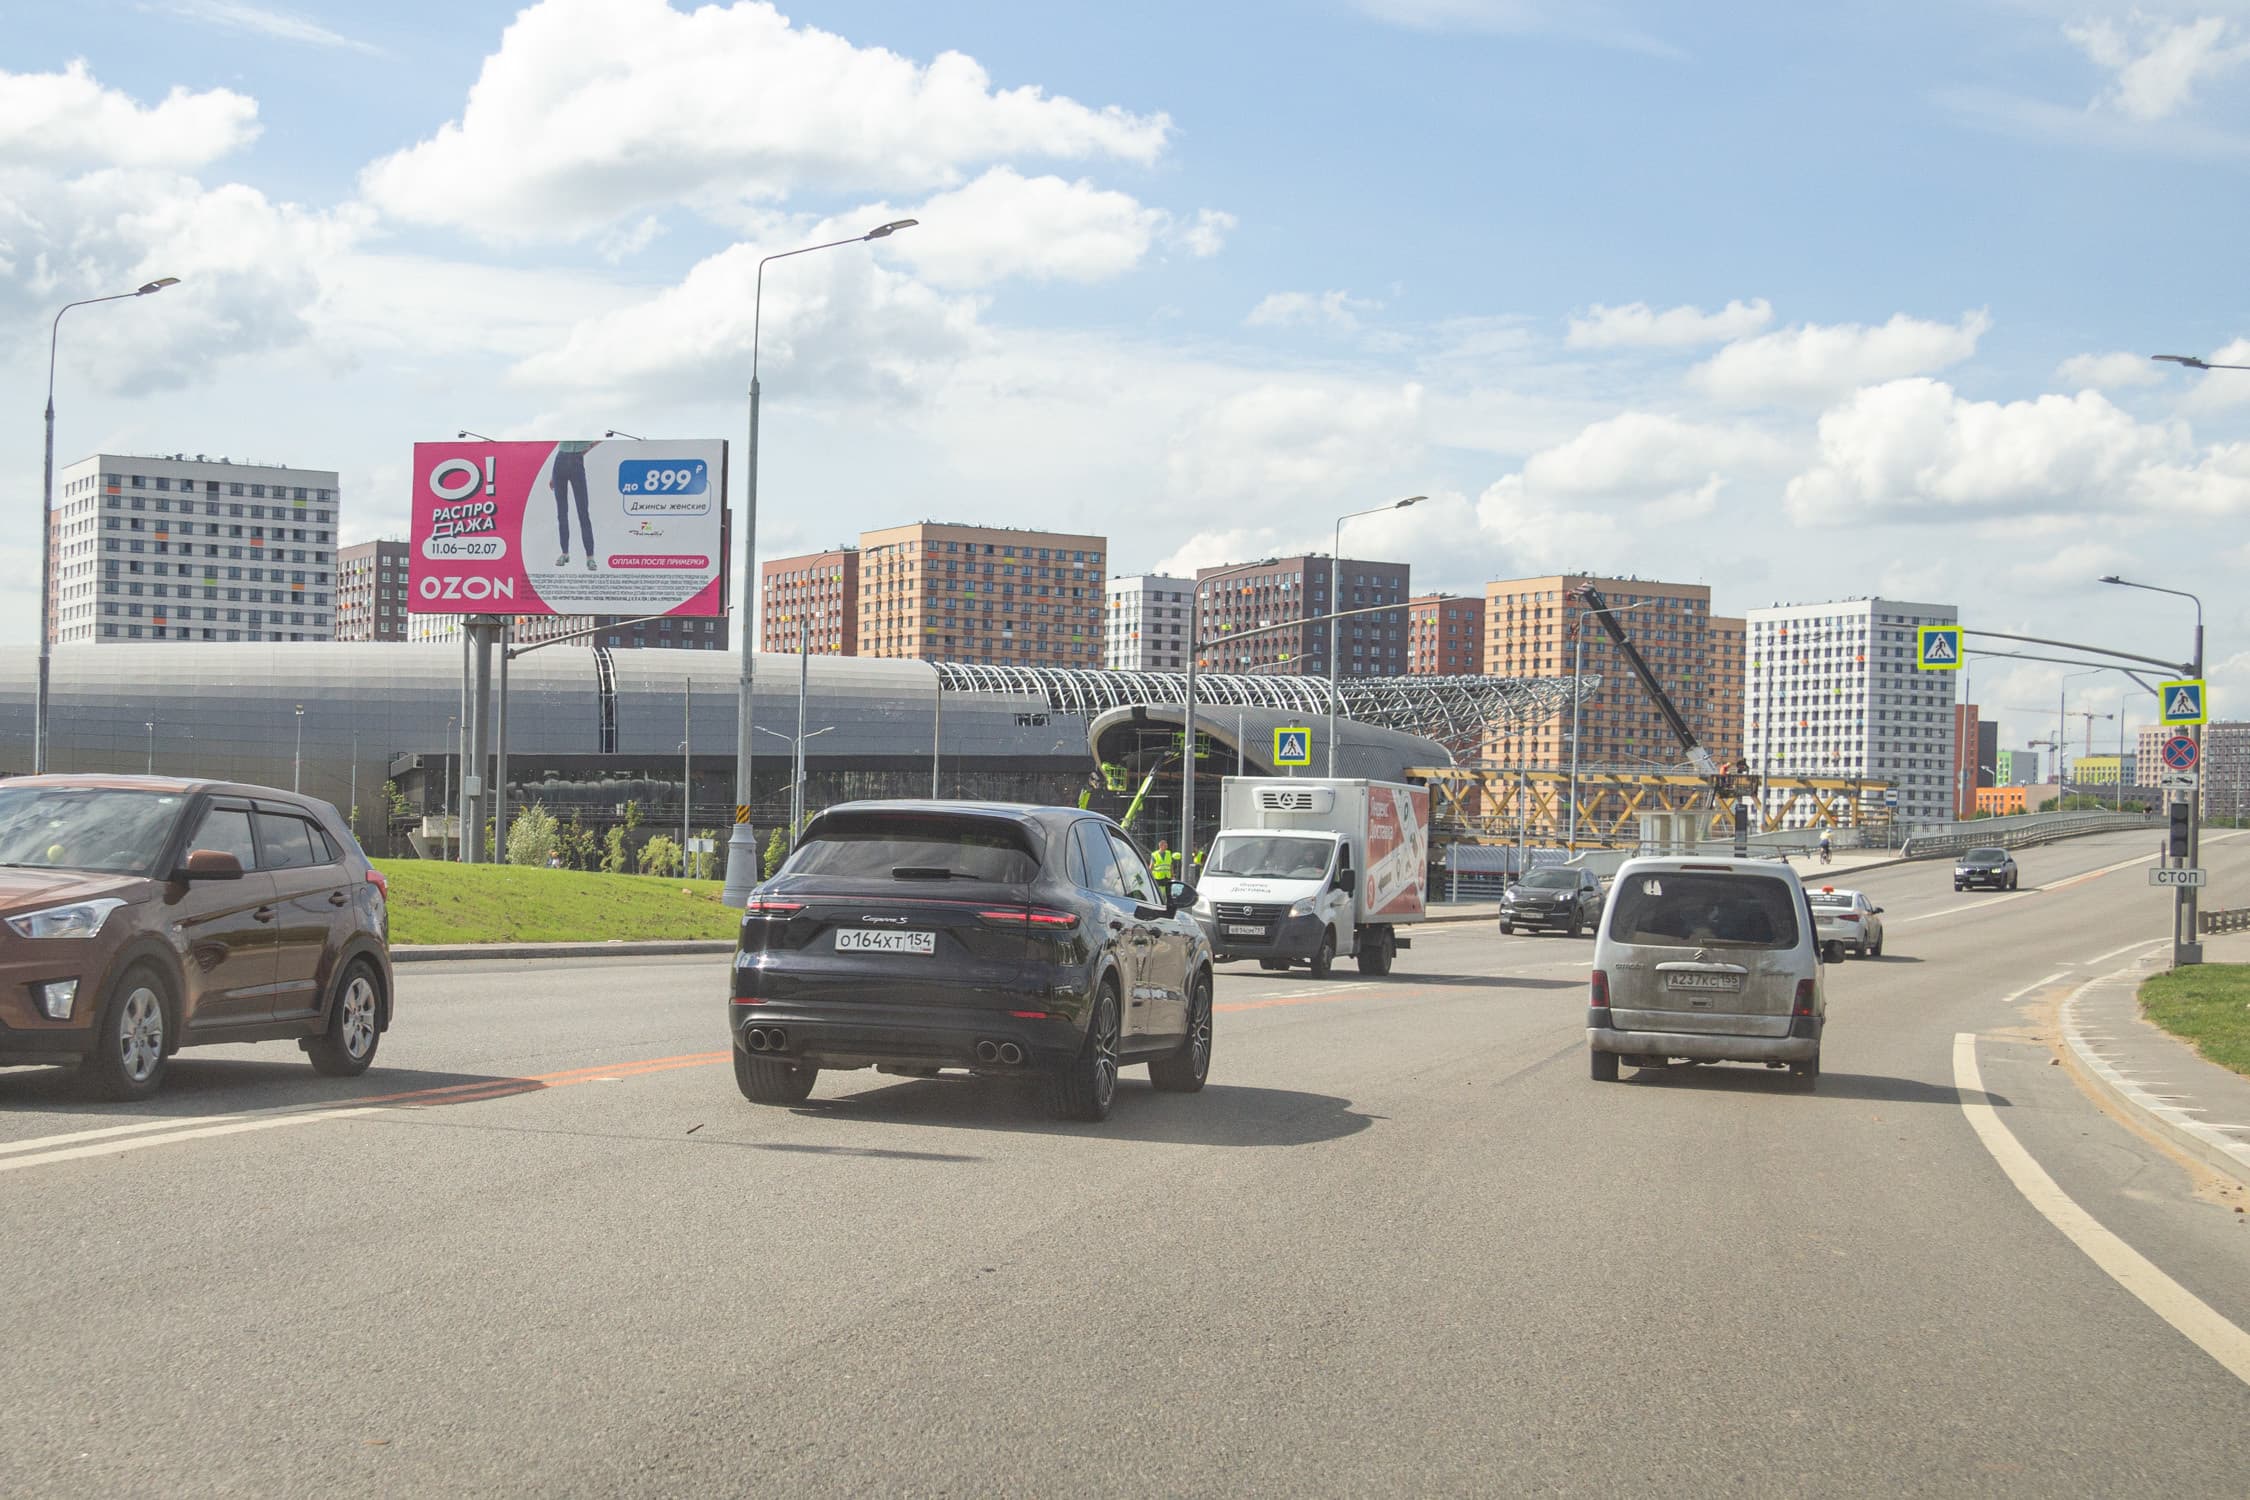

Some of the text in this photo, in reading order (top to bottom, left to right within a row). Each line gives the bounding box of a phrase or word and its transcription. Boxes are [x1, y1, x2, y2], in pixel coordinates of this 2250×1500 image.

[623, 483, 638, 492] до
[644, 469, 691, 491] 899
[432, 501, 496, 522] РАСПРО
[631, 502, 706, 511] Джинсы женские
[431, 517, 496, 539] ДАЖА
[612, 558, 705, 566] ОПЛАТА ПОСЛЕ ПРИМЕРКИ
[420, 576, 514, 600] OZON
[2157, 871, 2198, 884] СТОП
